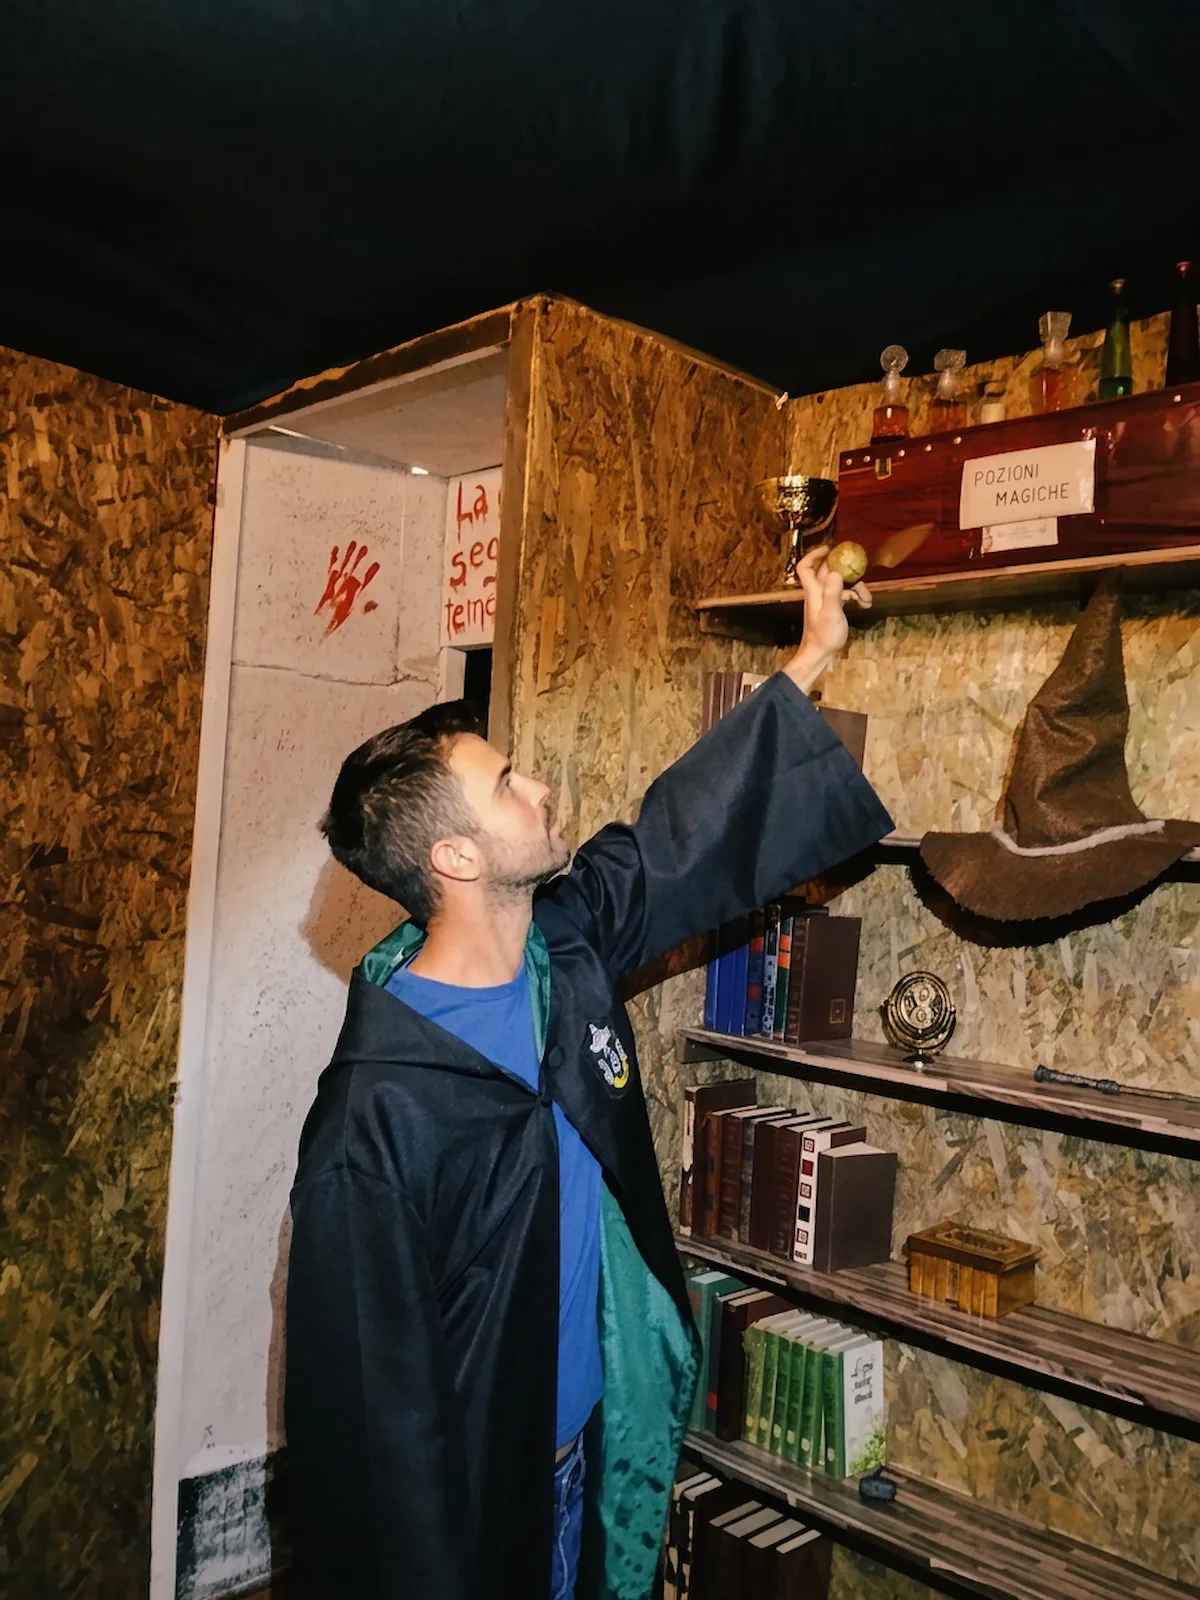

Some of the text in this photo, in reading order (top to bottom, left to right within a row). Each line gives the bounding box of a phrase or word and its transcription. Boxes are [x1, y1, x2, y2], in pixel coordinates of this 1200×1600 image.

[974, 463, 1039, 487] POZIONI
[996, 482, 1070, 507] MAGICHE
[457, 481, 489, 541] La
